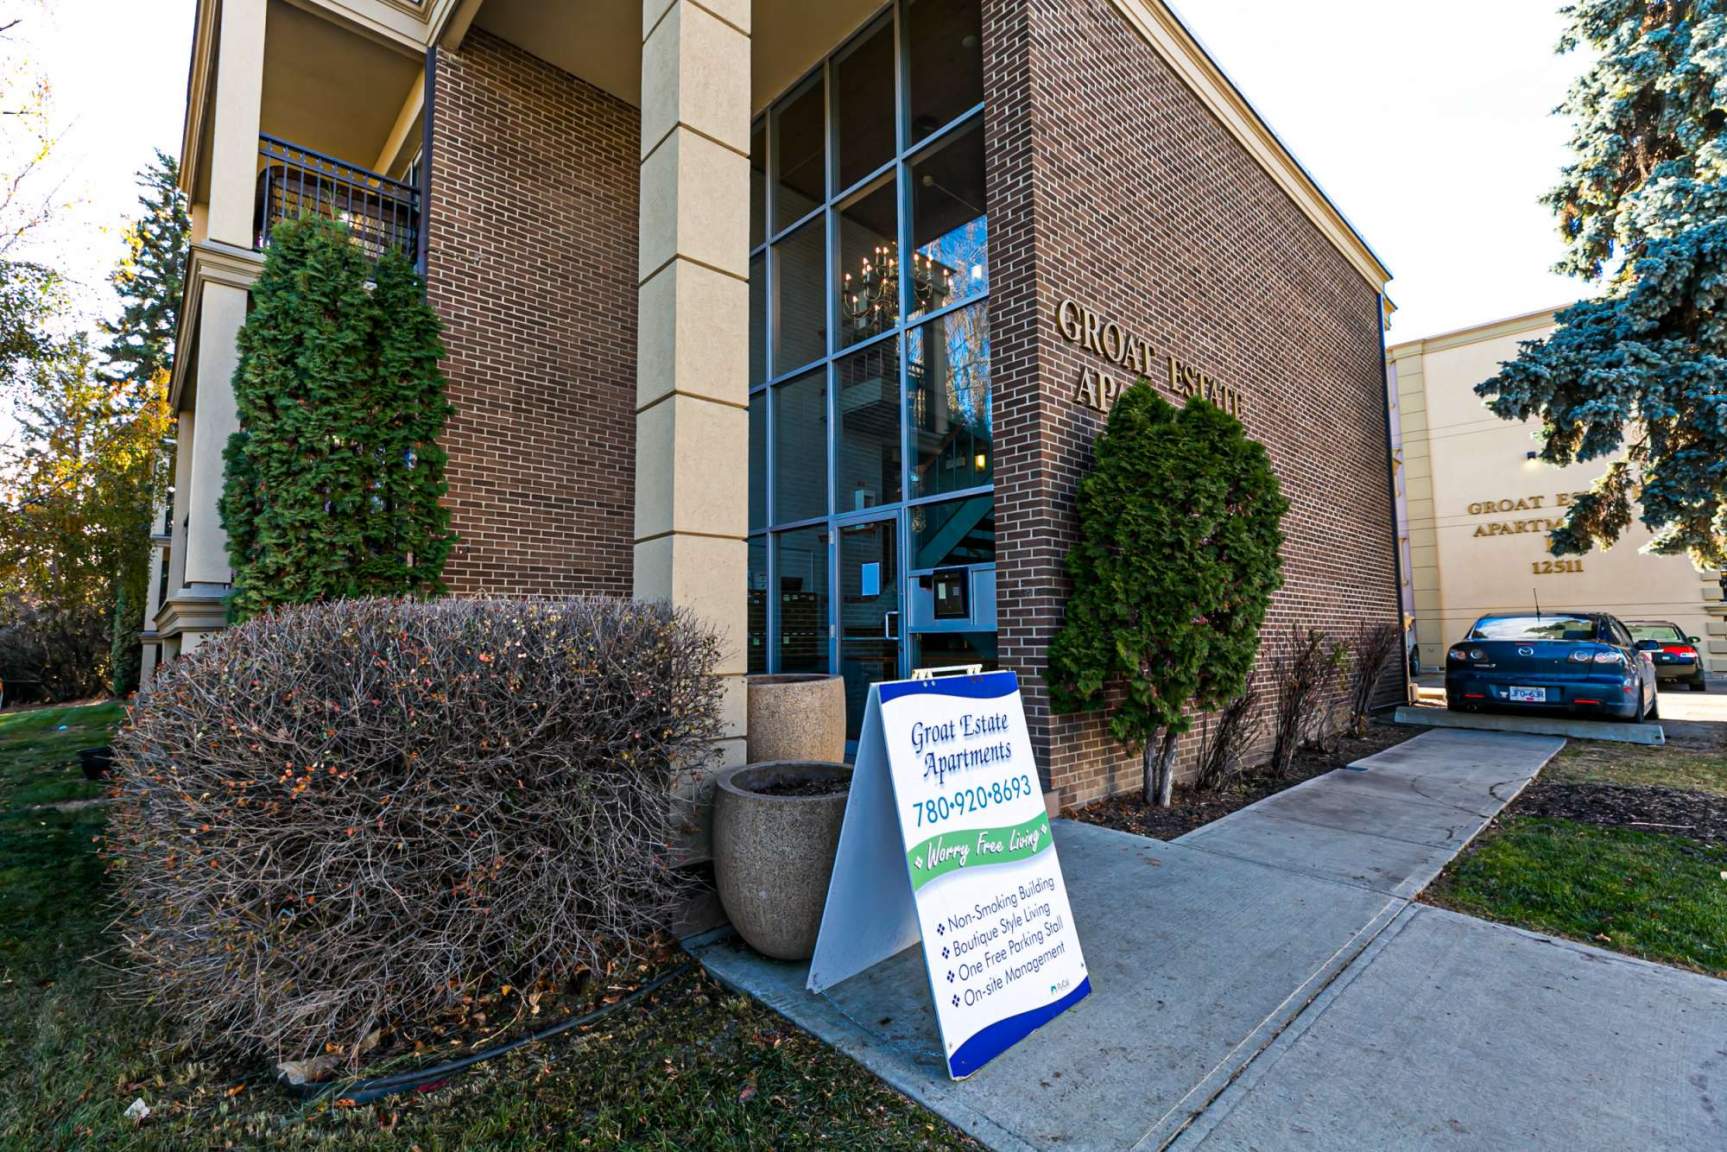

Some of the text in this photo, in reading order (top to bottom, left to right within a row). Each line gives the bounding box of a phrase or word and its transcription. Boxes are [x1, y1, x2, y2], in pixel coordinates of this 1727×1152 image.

[1056, 299, 1155, 378] GROAT
[1467, 495, 1545, 515] GROAT
[1531, 559, 1584, 575] 12511
[911, 711, 1009, 754] Groat Estate
[923, 740, 1012, 784] Apartments
[926, 828, 1041, 870] Worry Free Living
[947, 877, 1055, 933] Non-Smoking Building
[953, 902, 1051, 957] Boutique Style Living
[958, 914, 1064, 981] One Free Parking Stall
[964, 940, 1065, 1006] On-site Management
